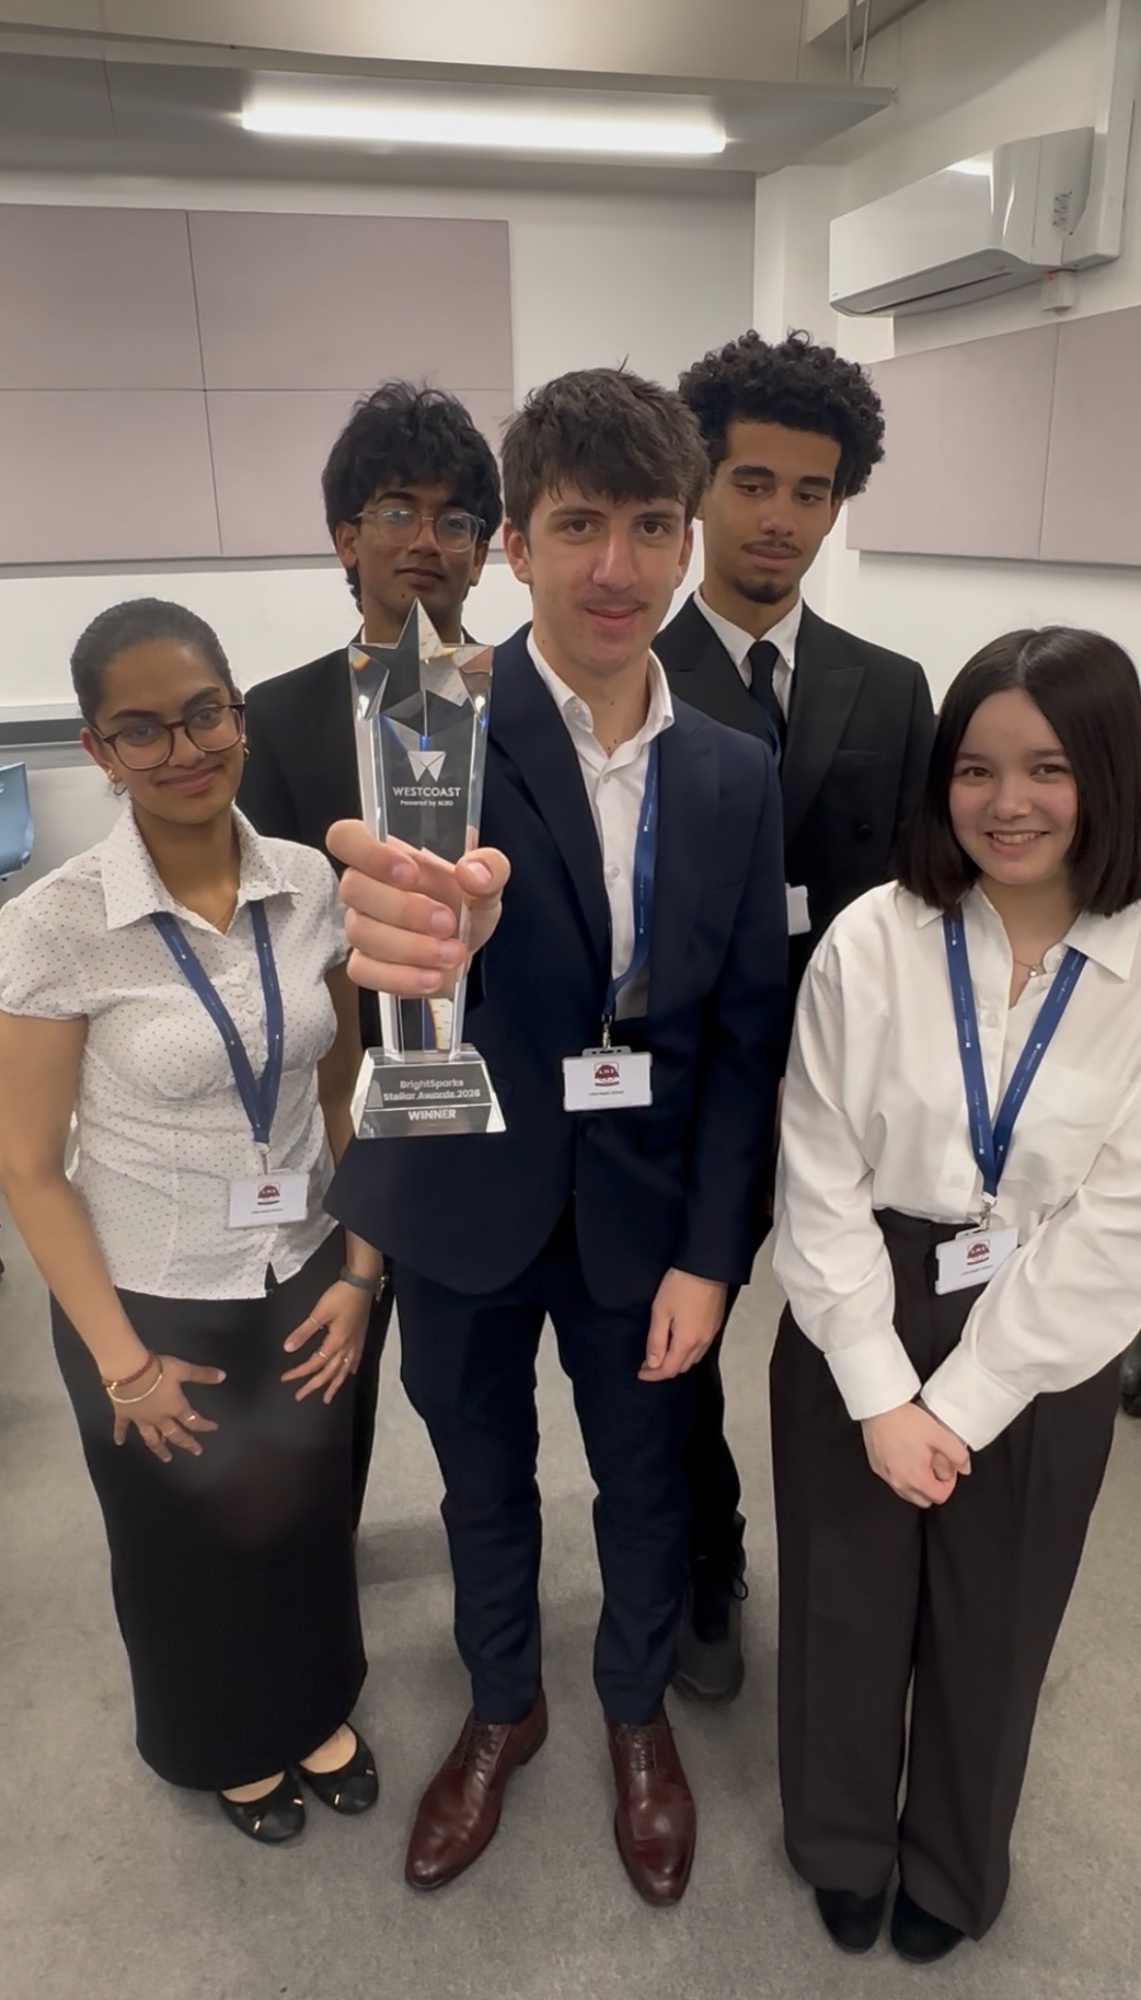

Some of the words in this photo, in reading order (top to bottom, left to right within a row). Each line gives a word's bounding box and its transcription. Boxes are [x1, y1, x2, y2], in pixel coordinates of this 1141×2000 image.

[392, 786, 461, 797] WESTCOAST
[400, 1079, 464, 1090] BrightSparks
[383, 1092, 415, 1101] Stellar
[417, 1090, 455, 1100] Awards
[408, 1109, 456, 1121] WINNER
